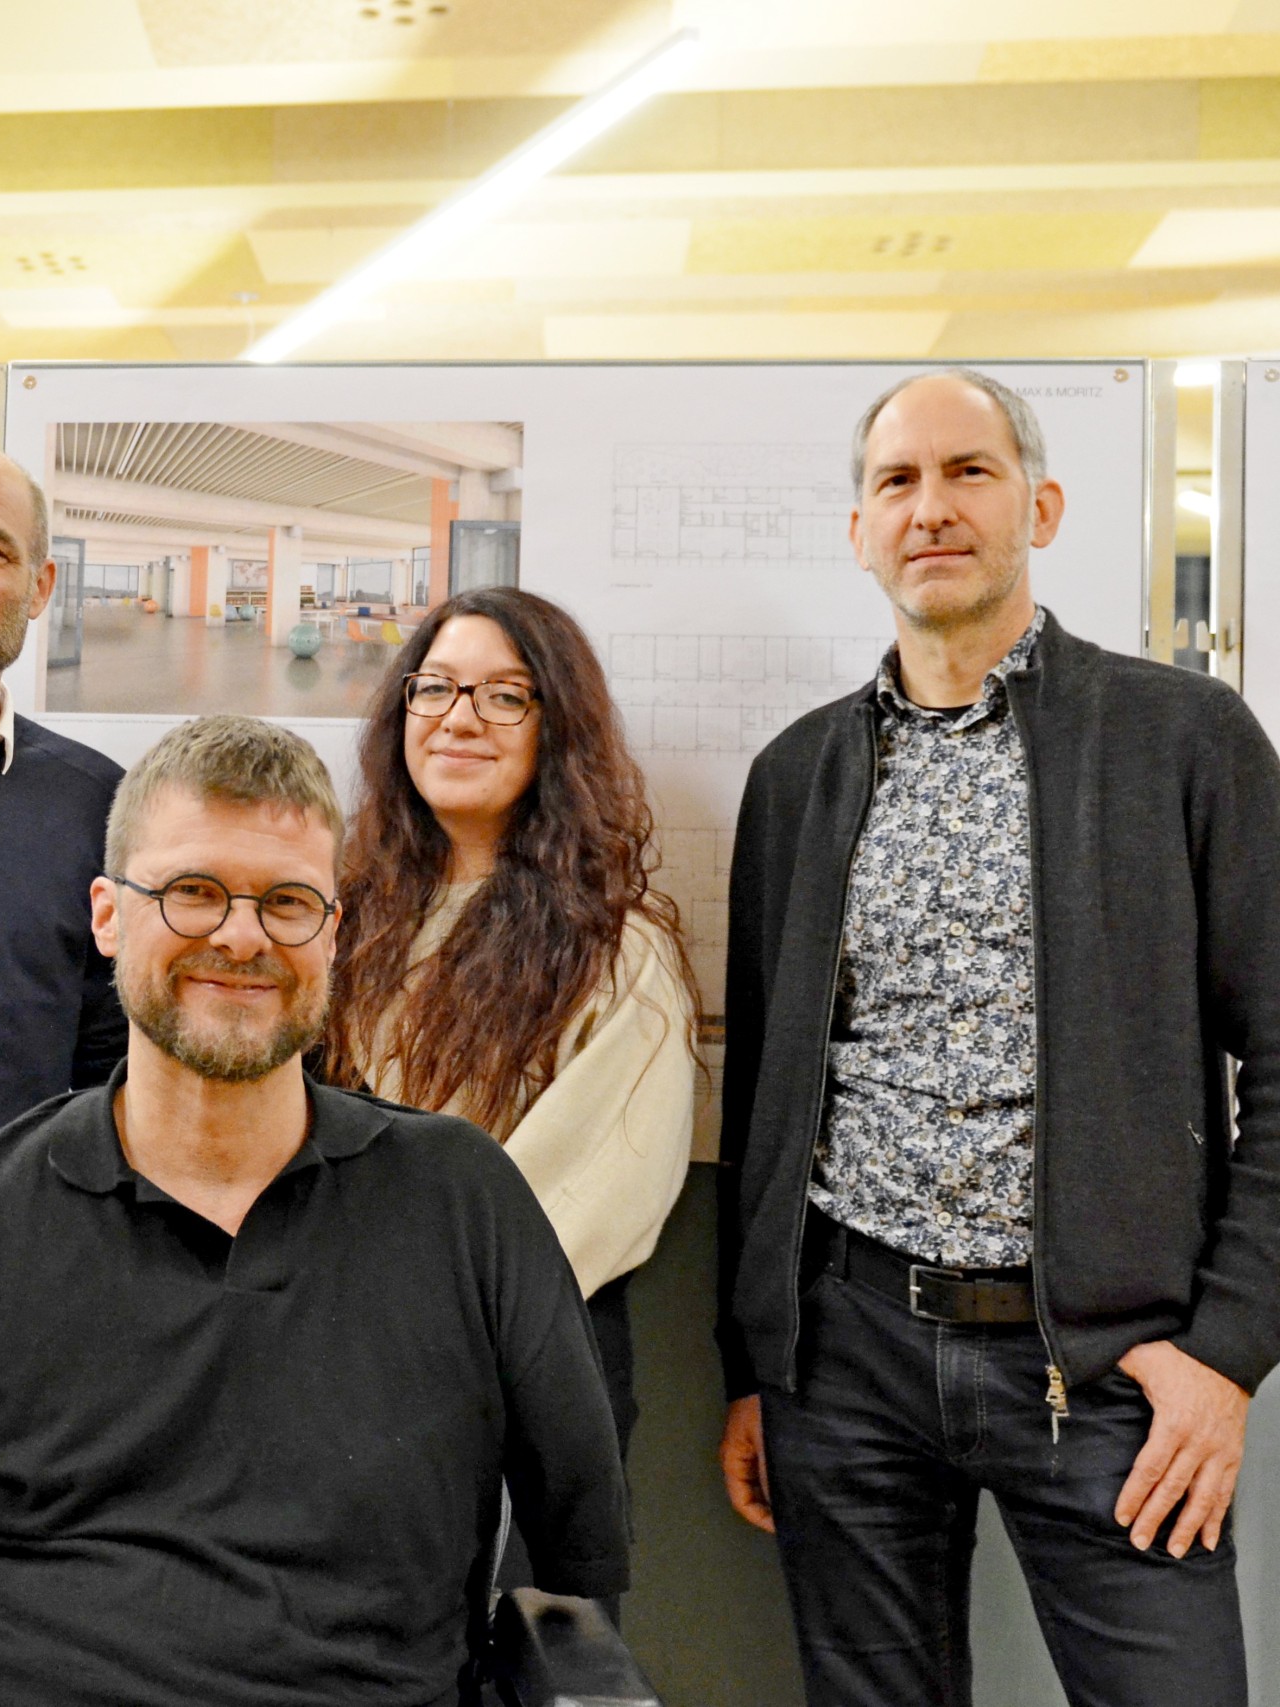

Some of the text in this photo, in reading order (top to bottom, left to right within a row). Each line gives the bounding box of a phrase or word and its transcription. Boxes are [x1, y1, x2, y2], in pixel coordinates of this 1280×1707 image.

[1016, 386, 1103, 398] MAX & MORITZ
